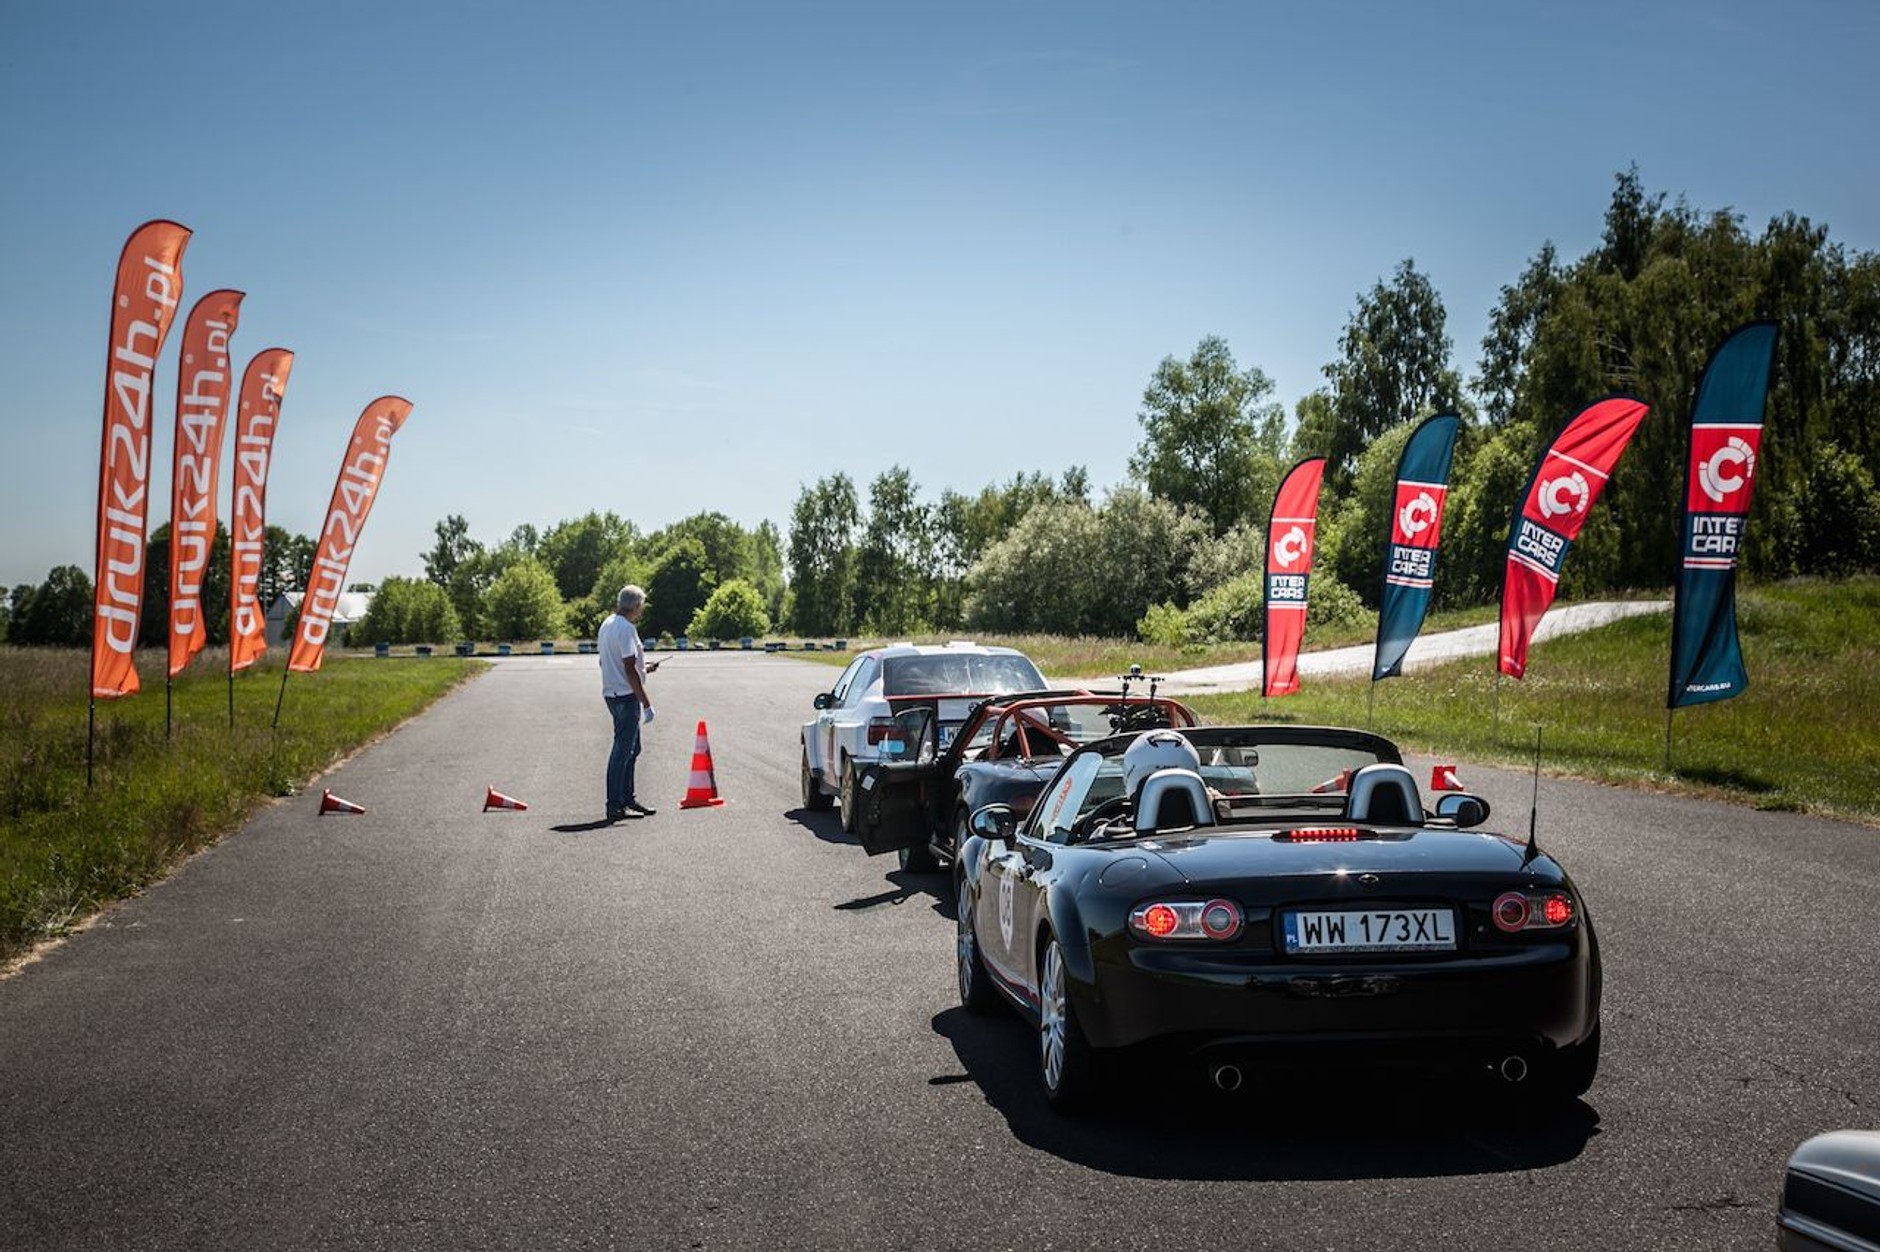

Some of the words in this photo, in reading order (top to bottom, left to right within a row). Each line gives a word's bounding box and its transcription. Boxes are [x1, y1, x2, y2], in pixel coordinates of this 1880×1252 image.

[98, 255, 177, 654] druk24h.pl
[1693, 516, 1747, 534] INTE
[1521, 520, 1564, 553] INTER
[1692, 535, 1743, 552] CAR
[1393, 546, 1431, 563] INTER
[1517, 534, 1557, 567] CARS
[1391, 560, 1429, 577] CARS
[1271, 575, 1305, 587] INTER
[1271, 587, 1304, 599] CARS
[1303, 914, 1346, 944] WW
[1359, 912, 1450, 943] 173XL
[1286, 935, 1298, 944] PL
